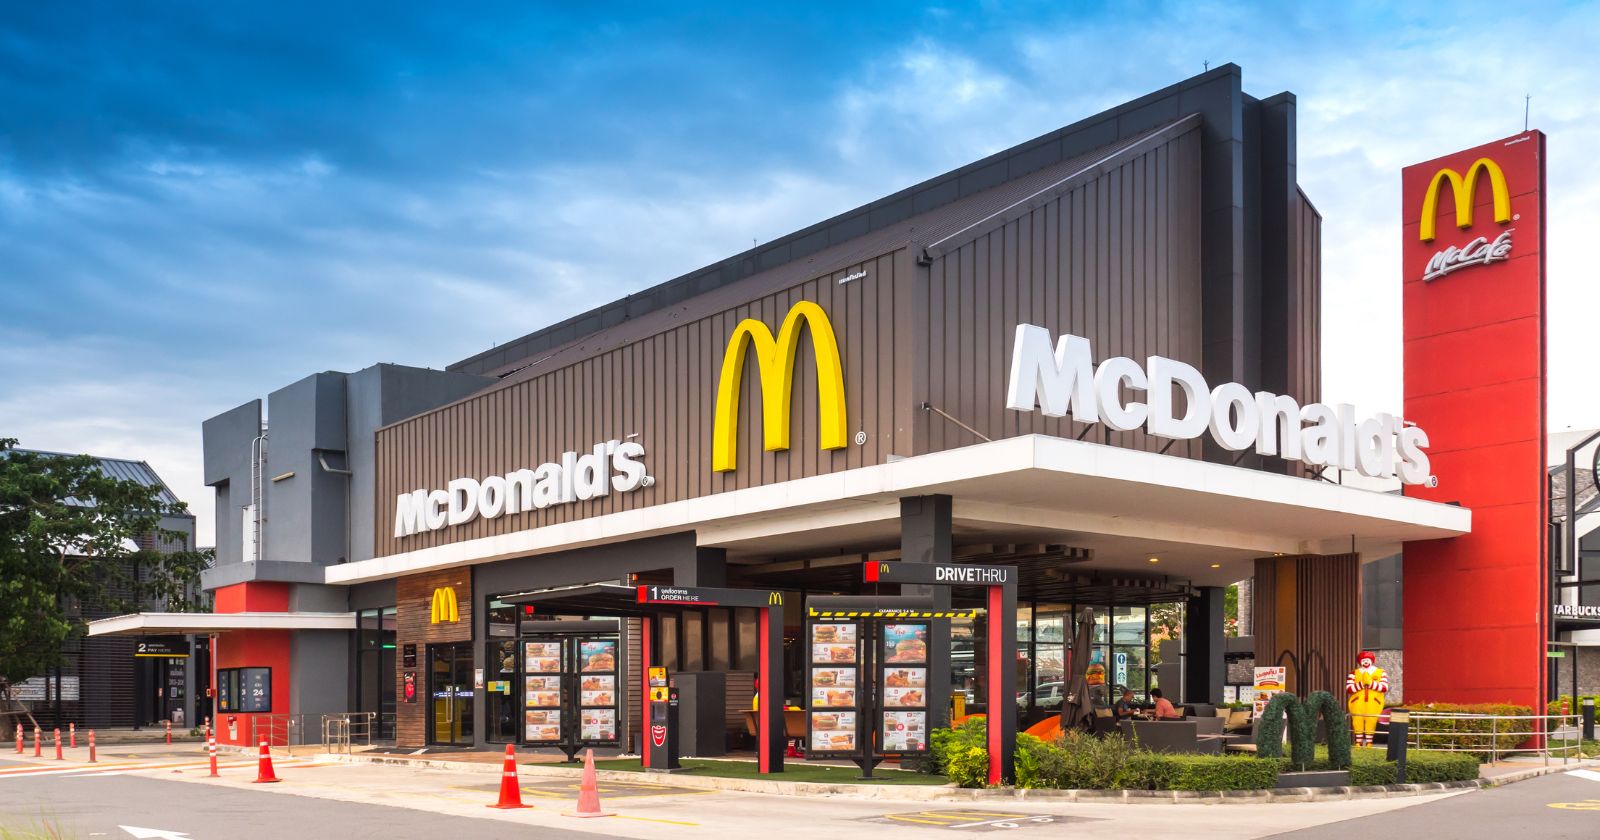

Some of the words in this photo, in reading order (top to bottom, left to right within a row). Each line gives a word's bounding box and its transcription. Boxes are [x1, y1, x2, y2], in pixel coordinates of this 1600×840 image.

[1006, 323, 1431, 486] McDonald's
[394, 439, 646, 538] McDonald's
[651, 586, 658, 600] 1
[138, 643, 146, 653] 2
